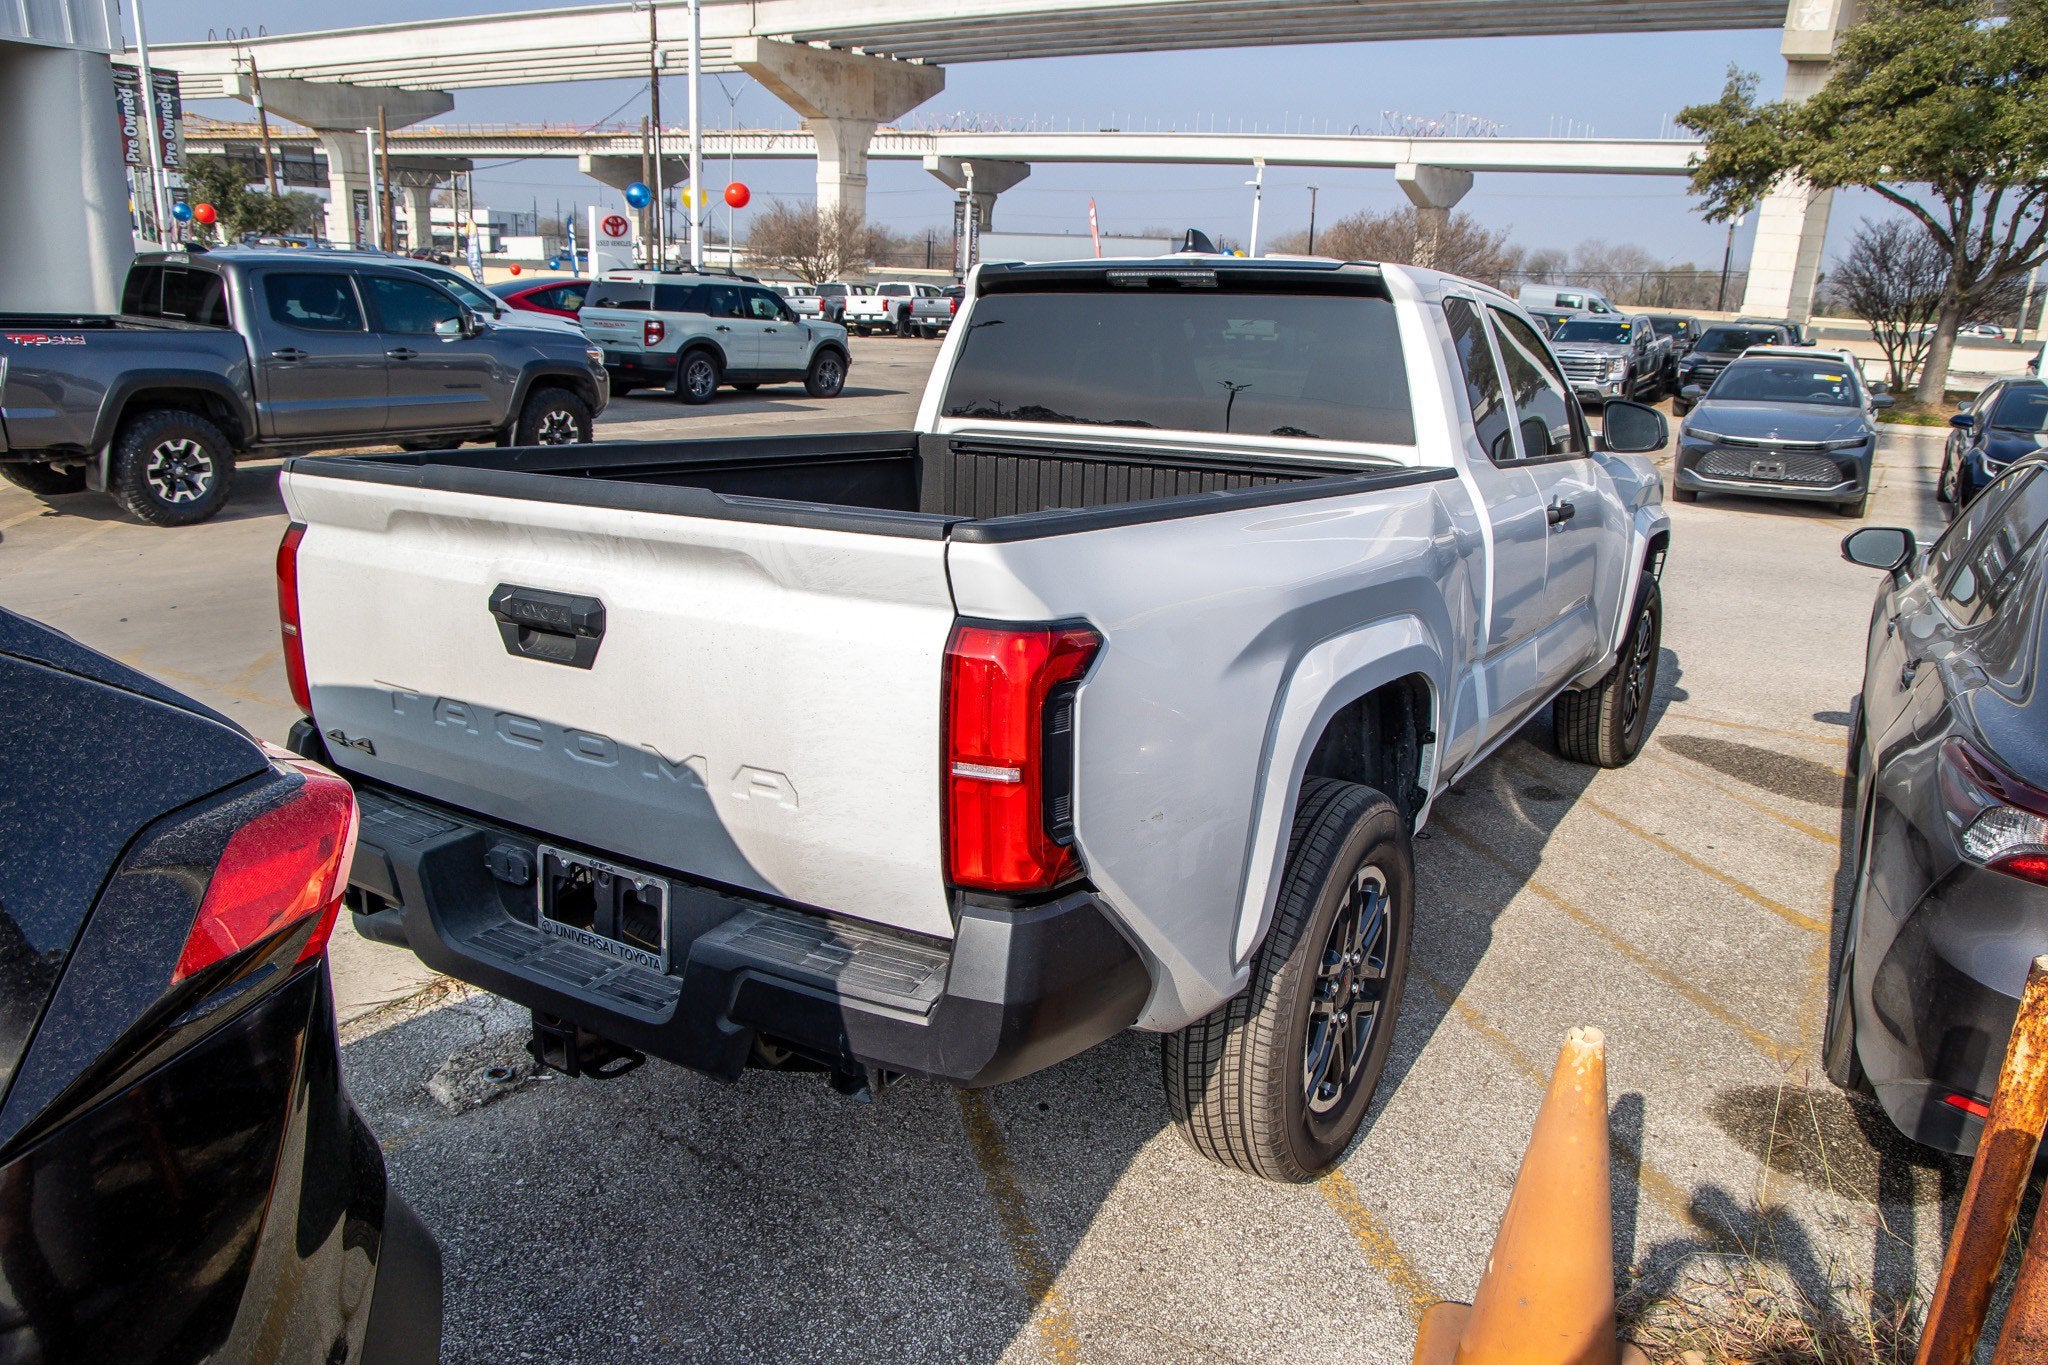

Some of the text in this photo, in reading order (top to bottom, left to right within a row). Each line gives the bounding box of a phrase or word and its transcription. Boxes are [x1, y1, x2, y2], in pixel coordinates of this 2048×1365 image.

[118, 87, 138, 137] Owned
[157, 92, 176, 139] Owned
[126, 140, 140, 163] Pre
[164, 142, 178, 165] Pre
[356, 203, 366, 233] Owned
[4, 333, 51, 346] TRD
[513, 602, 569, 623] TOYOTA
[373, 679, 799, 812] TACOMA
[554, 926, 662, 972] UNIVERSAL TOYOTA
